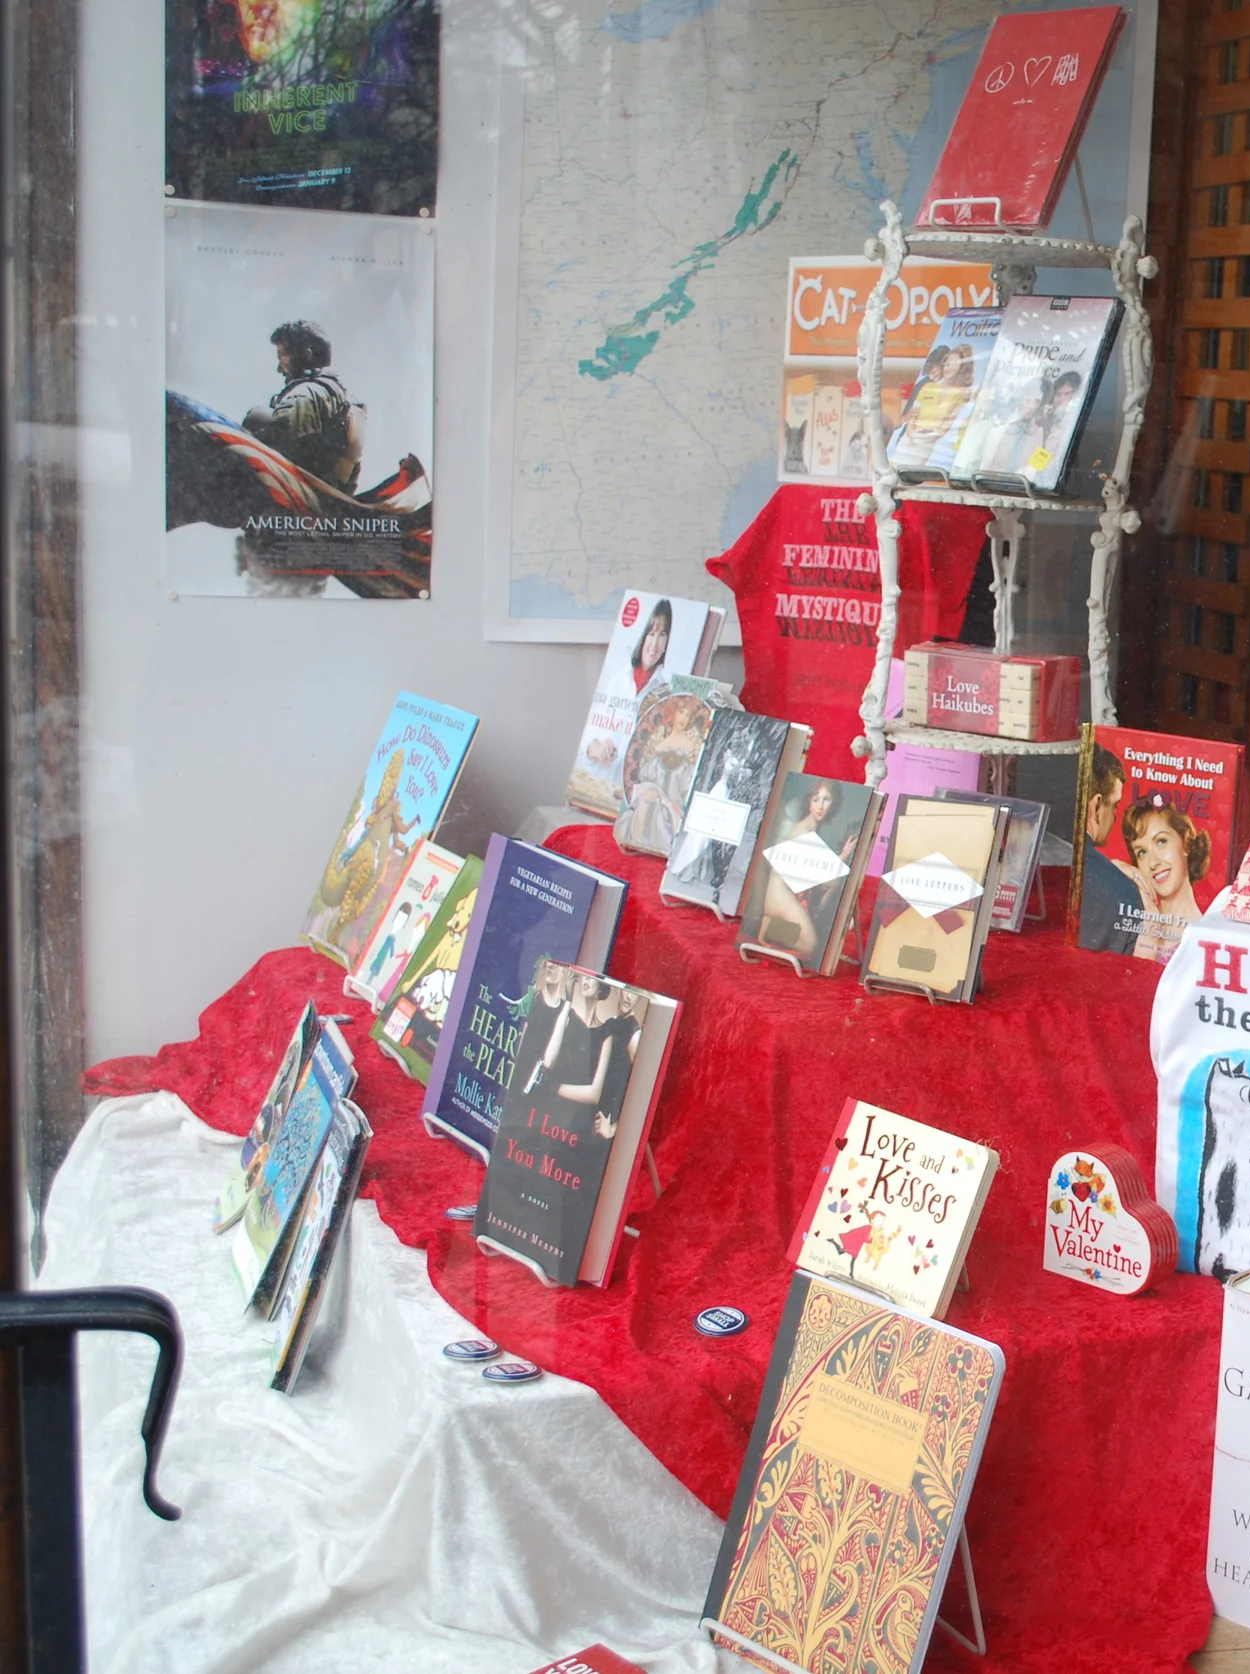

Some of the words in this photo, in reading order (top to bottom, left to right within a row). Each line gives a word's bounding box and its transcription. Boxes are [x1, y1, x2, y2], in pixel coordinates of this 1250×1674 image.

[234, 81, 359, 113] INHERENT
[268, 109, 326, 134] VICE
[298, 179, 330, 188] JANUARY
[307, 168, 343, 177] DECEMBER
[1012, 341, 1060, 362] PRIDE
[1059, 347, 1086, 363] and
[994, 359, 1060, 379] Prejudice
[245, 515, 337, 531] AMERICAN
[343, 518, 400, 532] SNIPER
[782, 544, 880, 574] FEMININ
[775, 593, 882, 626] MYSTIQU
[947, 676, 980, 694] Love
[932, 692, 994, 716] Haikubes
[591, 706, 624, 732] make
[377, 733, 401, 764] How
[402, 724, 417, 744] Do
[417, 723, 451, 771] Dinosaurs
[1124, 747, 1184, 770] Everything
[1186, 756, 1193, 769] I
[1195, 758, 1224, 774] Need
[407, 748, 422, 772] Say
[424, 760, 438, 798] Love
[1131, 766, 1143, 778] to
[1146, 768, 1178, 784] Know
[1180, 773, 1214, 790] About
[405, 774, 425, 804] You?
[774, 851, 799, 865] LOVE
[803, 857, 837, 872] POEMS
[509, 876, 522, 889] FOR
[525, 883, 538, 899] NEW
[537, 889, 575, 915] GENERATION
[517, 866, 551, 888] VEGETARIAN
[550, 882, 573, 900] RECIPES
[900, 875, 921, 887] LOVE
[924, 878, 966, 893] LETTERS
[1113, 922, 1121, 931] a
[1118, 903, 1125, 916] I
[1127, 904, 1173, 925] Learned
[478, 983, 493, 1005] The
[463, 1043, 476, 1063] the
[475, 1042, 517, 1090] PLAT
[454, 1072, 484, 1110] Mollie
[484, 1092, 503, 1123] Kat
[527, 1107, 536, 1129] I
[541, 1113, 578, 1148] Love
[859, 1114, 917, 1164] Love
[919, 1151, 945, 1175] and
[506, 1138, 534, 1169] You
[538, 1151, 582, 1192] More
[528, 1194, 550, 1211] NOVEL
[867, 1156, 957, 1225] Kisses
[1066, 1200, 1105, 1242] My
[487, 1210, 528, 1241] JENNIFER
[530, 1231, 565, 1260] MURPHY
[1049, 1223, 1144, 1279] Valentine
[707, 1312, 731, 1329] SMALL
[713, 1308, 735, 1323] SHOP
[819, 1382, 891, 1421] DECOMPOSITION
[892, 1414, 920, 1433] BOOK
